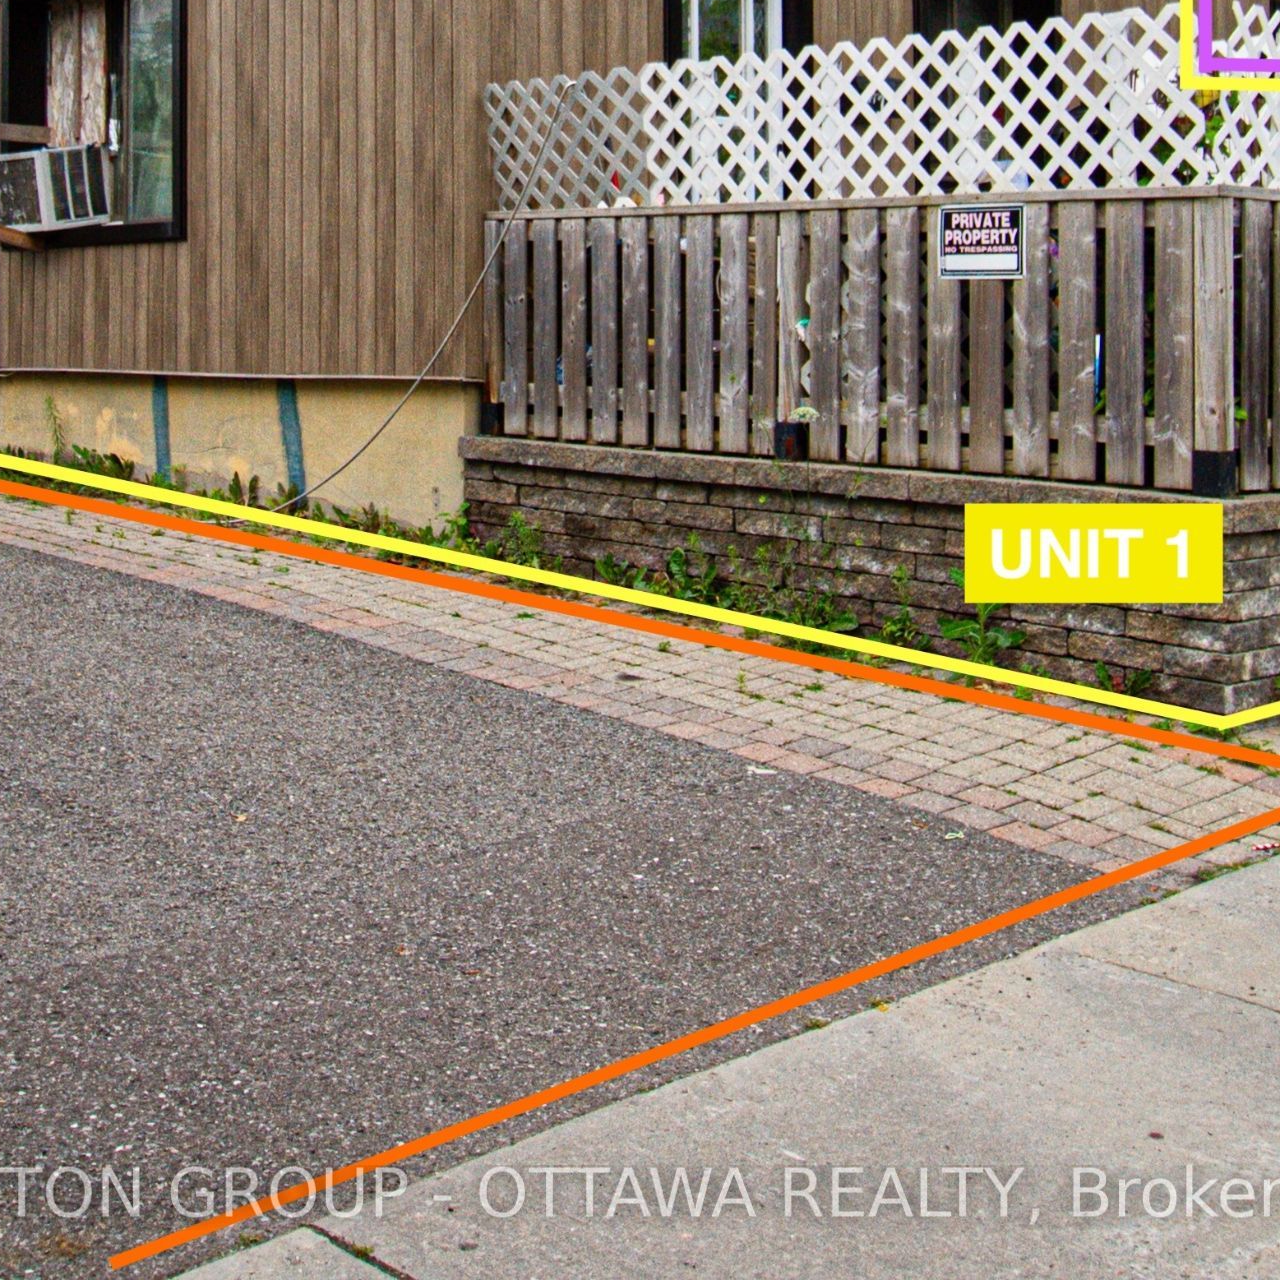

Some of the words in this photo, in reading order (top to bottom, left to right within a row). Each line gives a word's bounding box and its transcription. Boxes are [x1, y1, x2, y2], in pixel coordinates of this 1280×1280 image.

[951, 211, 1011, 229] PRIVATE
[944, 228, 1018, 245] PROPERTY
[960, 245, 1018, 253] TRESPASSING
